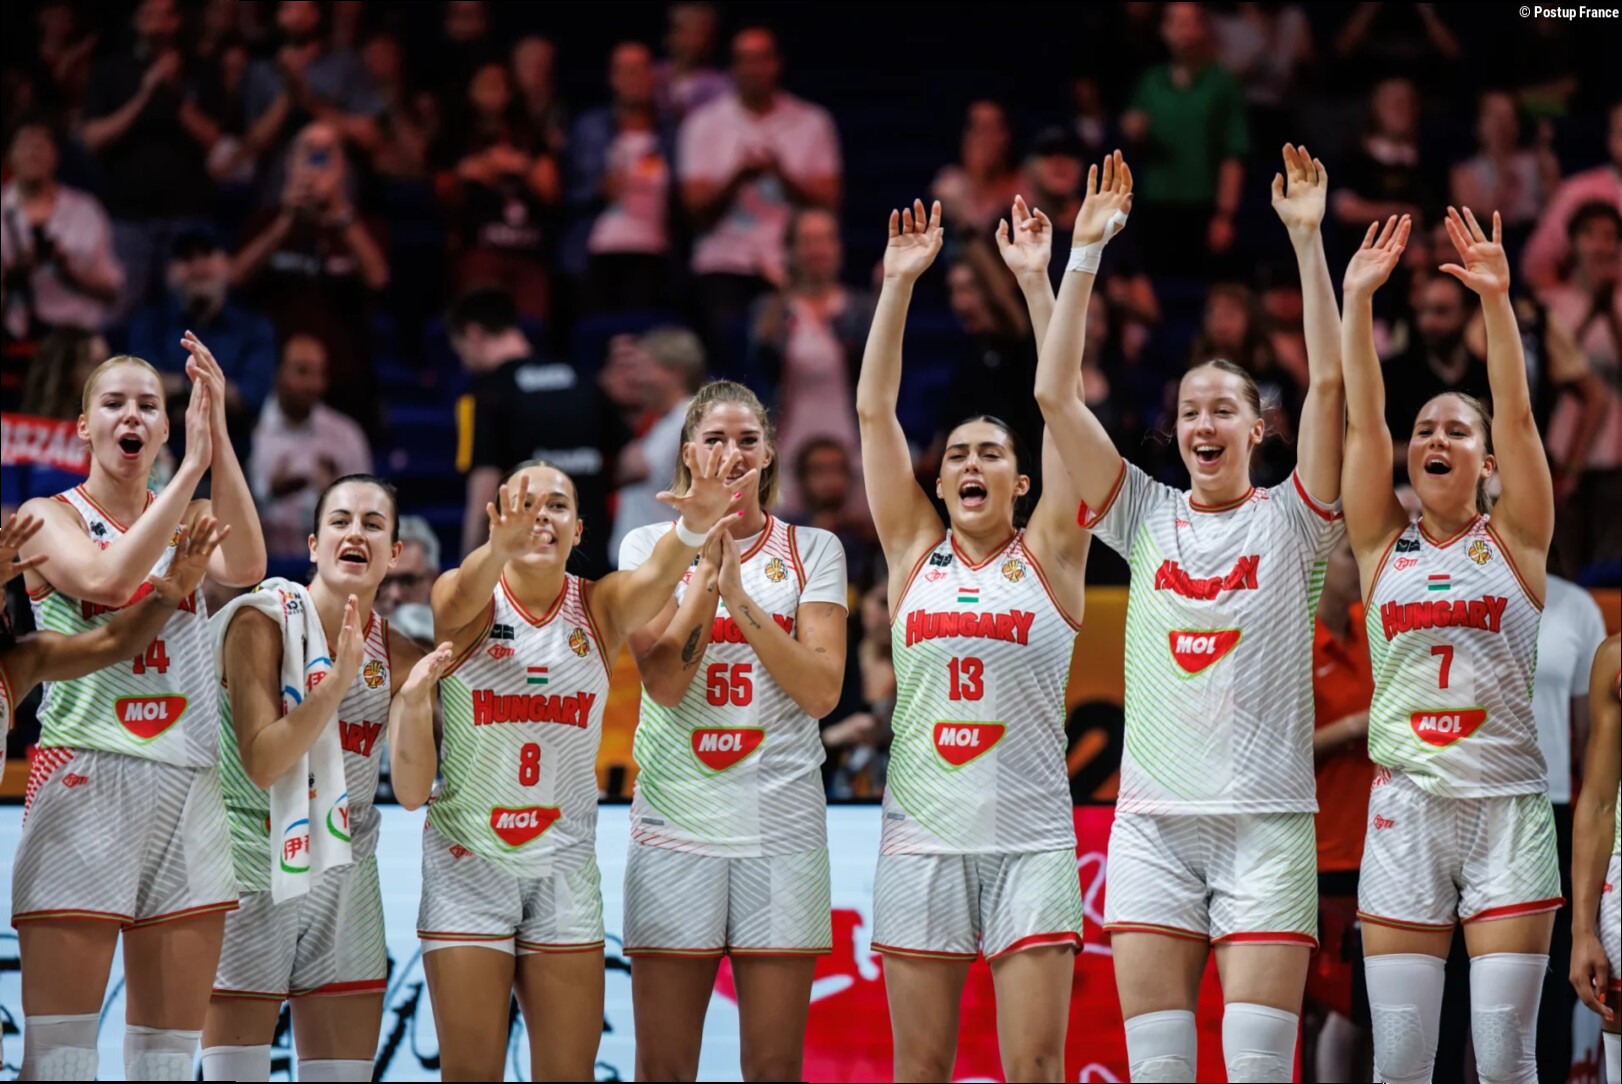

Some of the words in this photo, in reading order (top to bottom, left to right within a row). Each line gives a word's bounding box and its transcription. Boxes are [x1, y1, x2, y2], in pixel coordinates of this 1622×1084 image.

[905, 608, 1035, 648] HUNGARY
[1380, 595, 1508, 642] HUNGARY
[1175, 635, 1216, 655] MOL
[706, 662, 753, 707] 55
[947, 656, 984, 701] 13
[1431, 644, 1454, 689] 7
[125, 701, 168, 721] MOL
[472, 689, 596, 729] HUNGARY
[1418, 715, 1462, 733] MOL
[698, 733, 743, 752] MOL
[938, 726, 981, 747] MOL
[519, 742, 541, 787] 8
[496, 810, 539, 829] MOL
